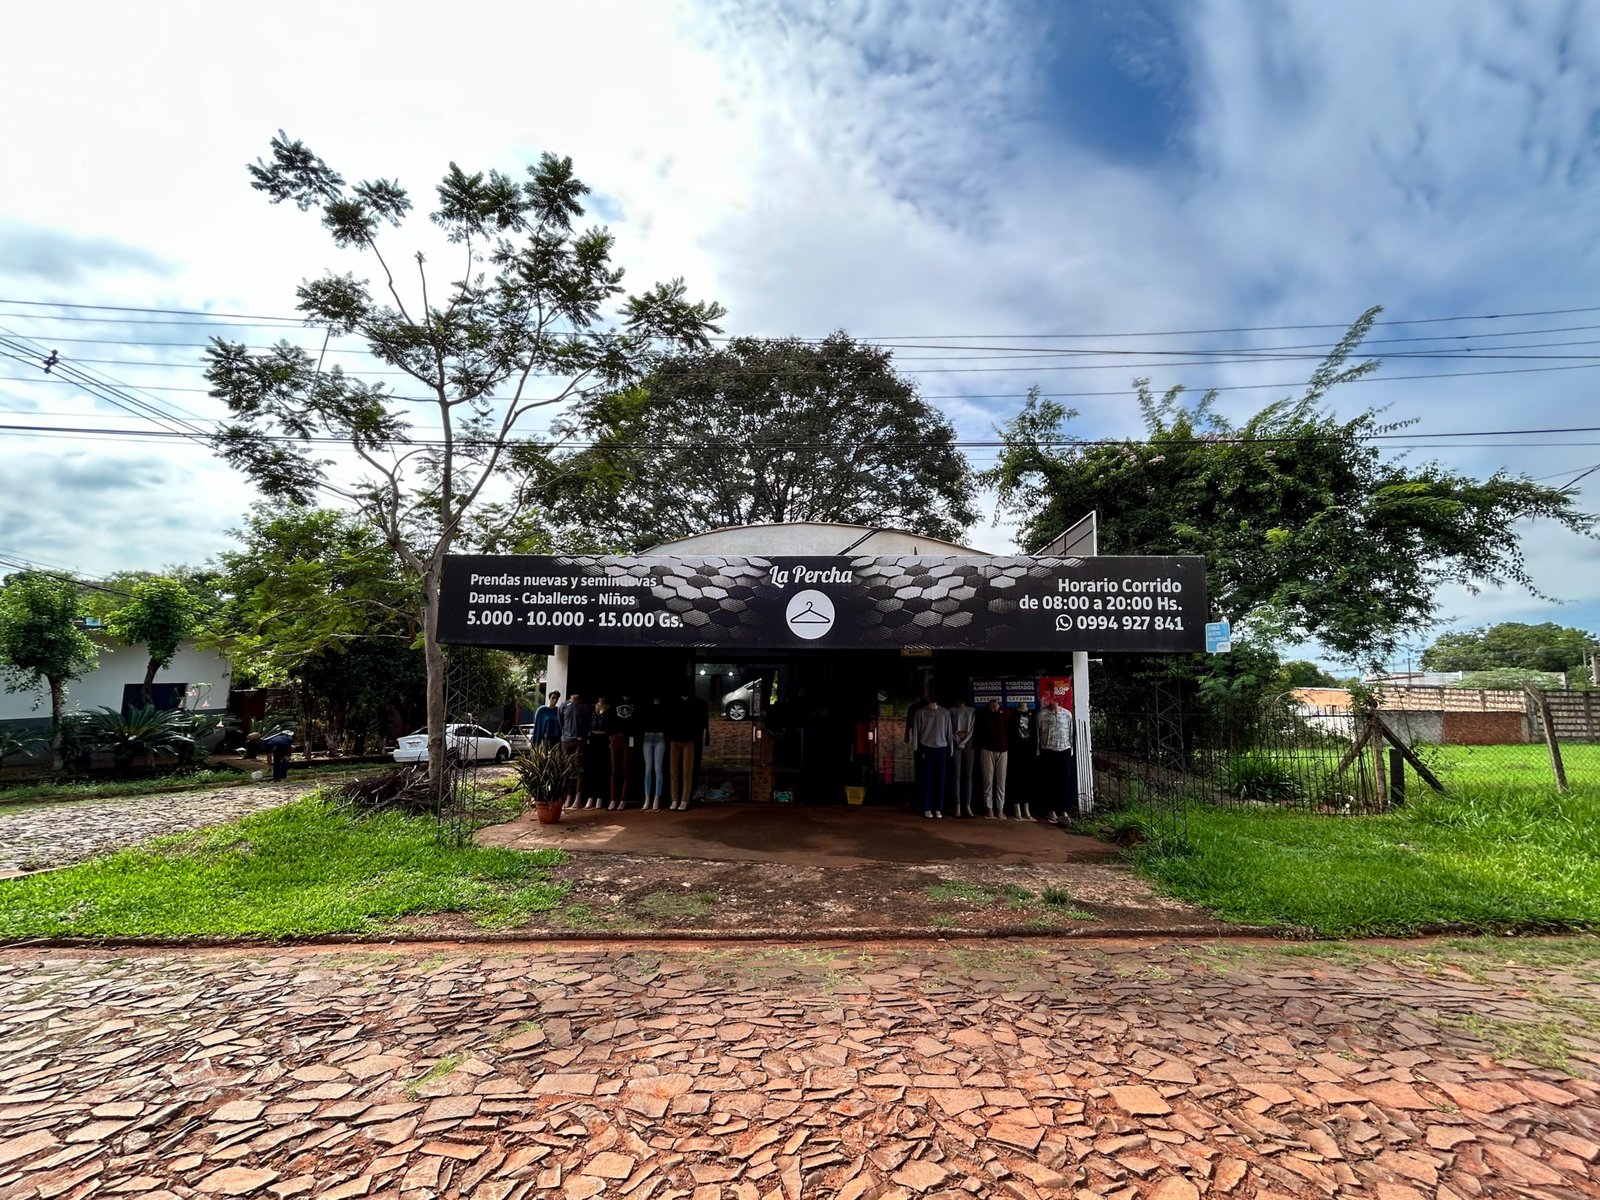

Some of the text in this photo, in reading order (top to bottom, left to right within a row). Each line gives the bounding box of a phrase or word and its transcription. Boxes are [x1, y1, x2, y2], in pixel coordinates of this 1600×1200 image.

[470, 573, 657, 590] Prendas nuevas y seminvas
[769, 565, 853, 589] La Percha
[1058, 577, 1182, 593] Horario Corrido
[469, 591, 512, 604] Damas
[521, 591, 588, 605] Caballeros
[598, 592, 636, 606] Niños
[1019, 595, 1183, 611] de 08:00 a 20:00 Hs.
[466, 610, 514, 626] 5.000
[526, 610, 585, 627] 10.000
[598, 611, 655, 628] 15.000
[659, 612, 684, 628] Gs.
[1076, 615, 1185, 631] 0994 927 841
